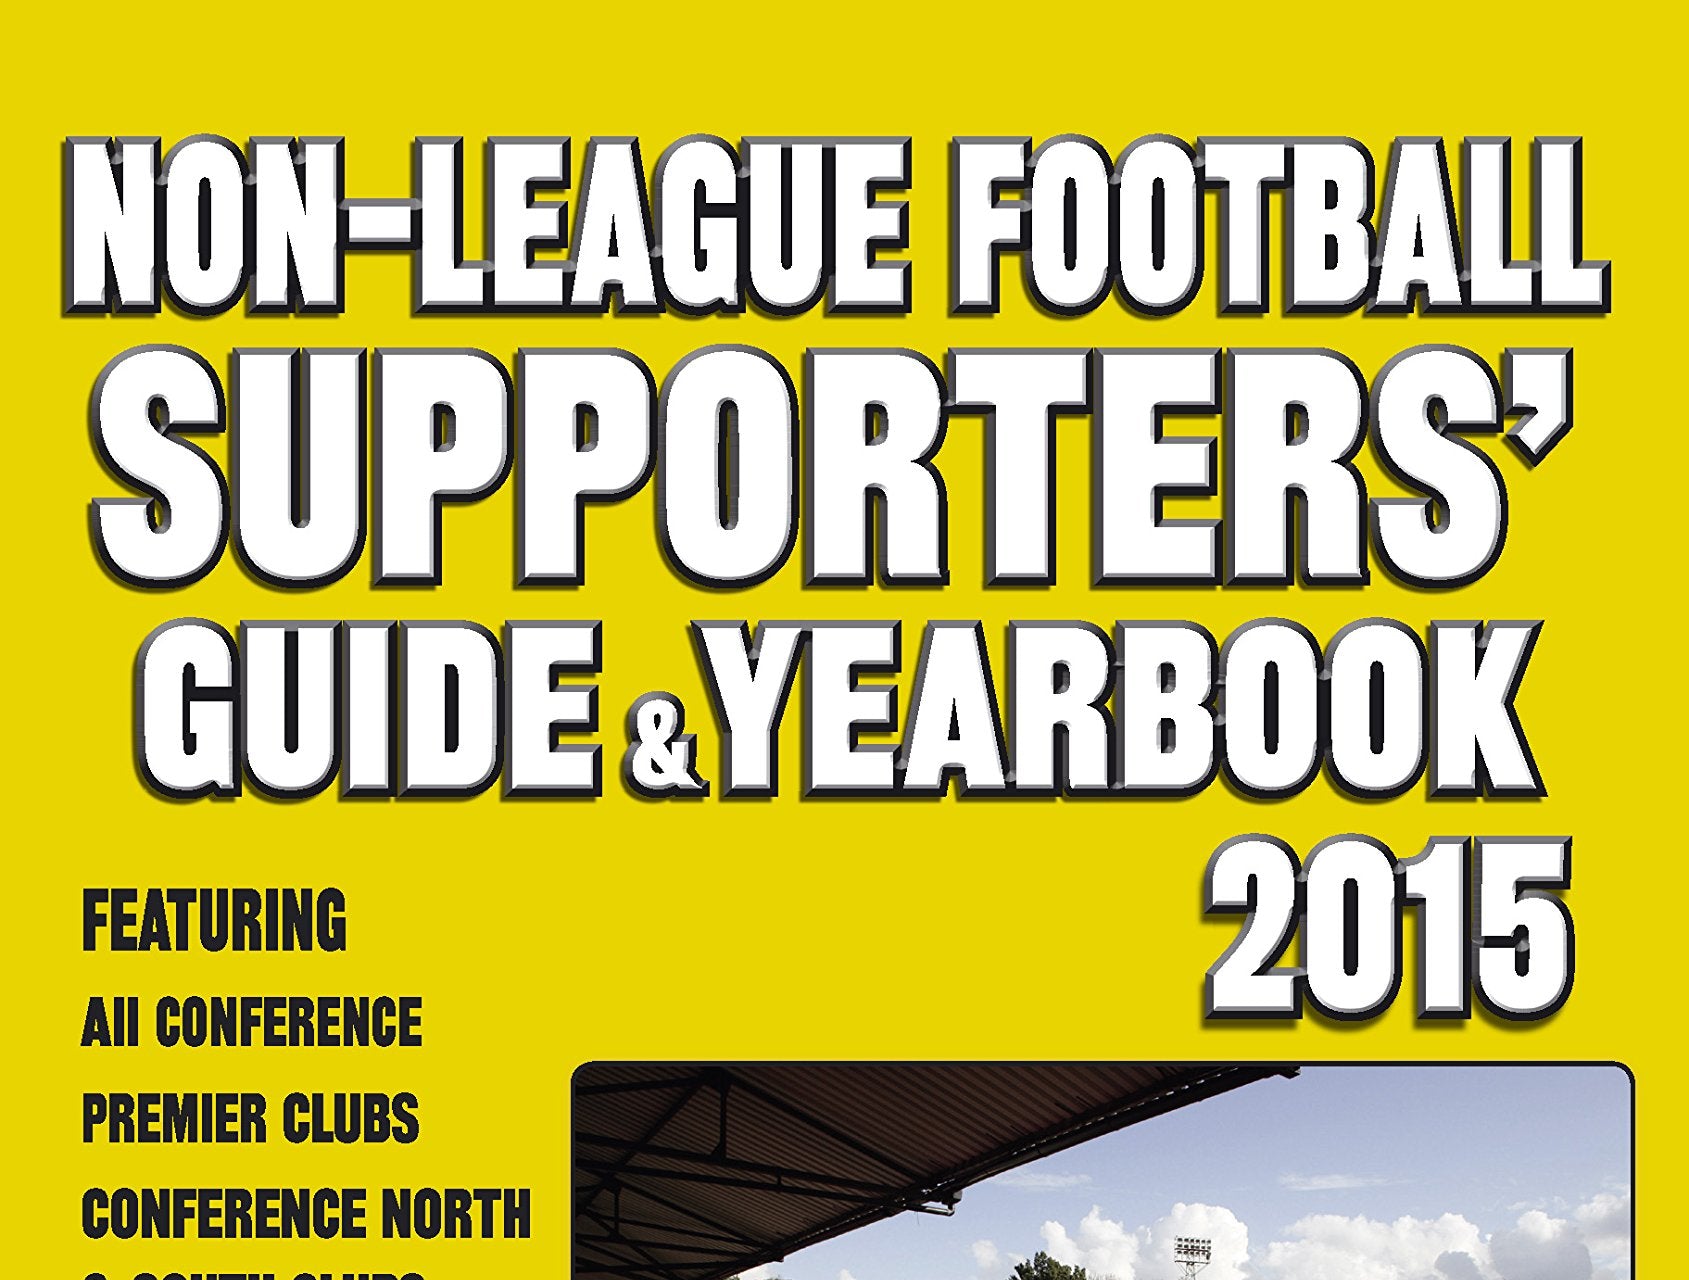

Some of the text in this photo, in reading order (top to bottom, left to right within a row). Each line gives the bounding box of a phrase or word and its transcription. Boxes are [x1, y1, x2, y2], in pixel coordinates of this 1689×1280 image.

[61, 134, 1612, 318] NON-LEAGUE FOOTBALL
[89, 343, 1575, 593] SUPPORTERS'
[133, 617, 1548, 803] GUIDE & YEARBOOK
[83, 888, 347, 953] FEATURING
[1202, 833, 1575, 1028] 2015
[157, 996, 423, 1047] CONFERENCE
[83, 1092, 420, 1143] PREMIER CLUBS
[82, 1188, 531, 1239] CONFERENCE NORTH
